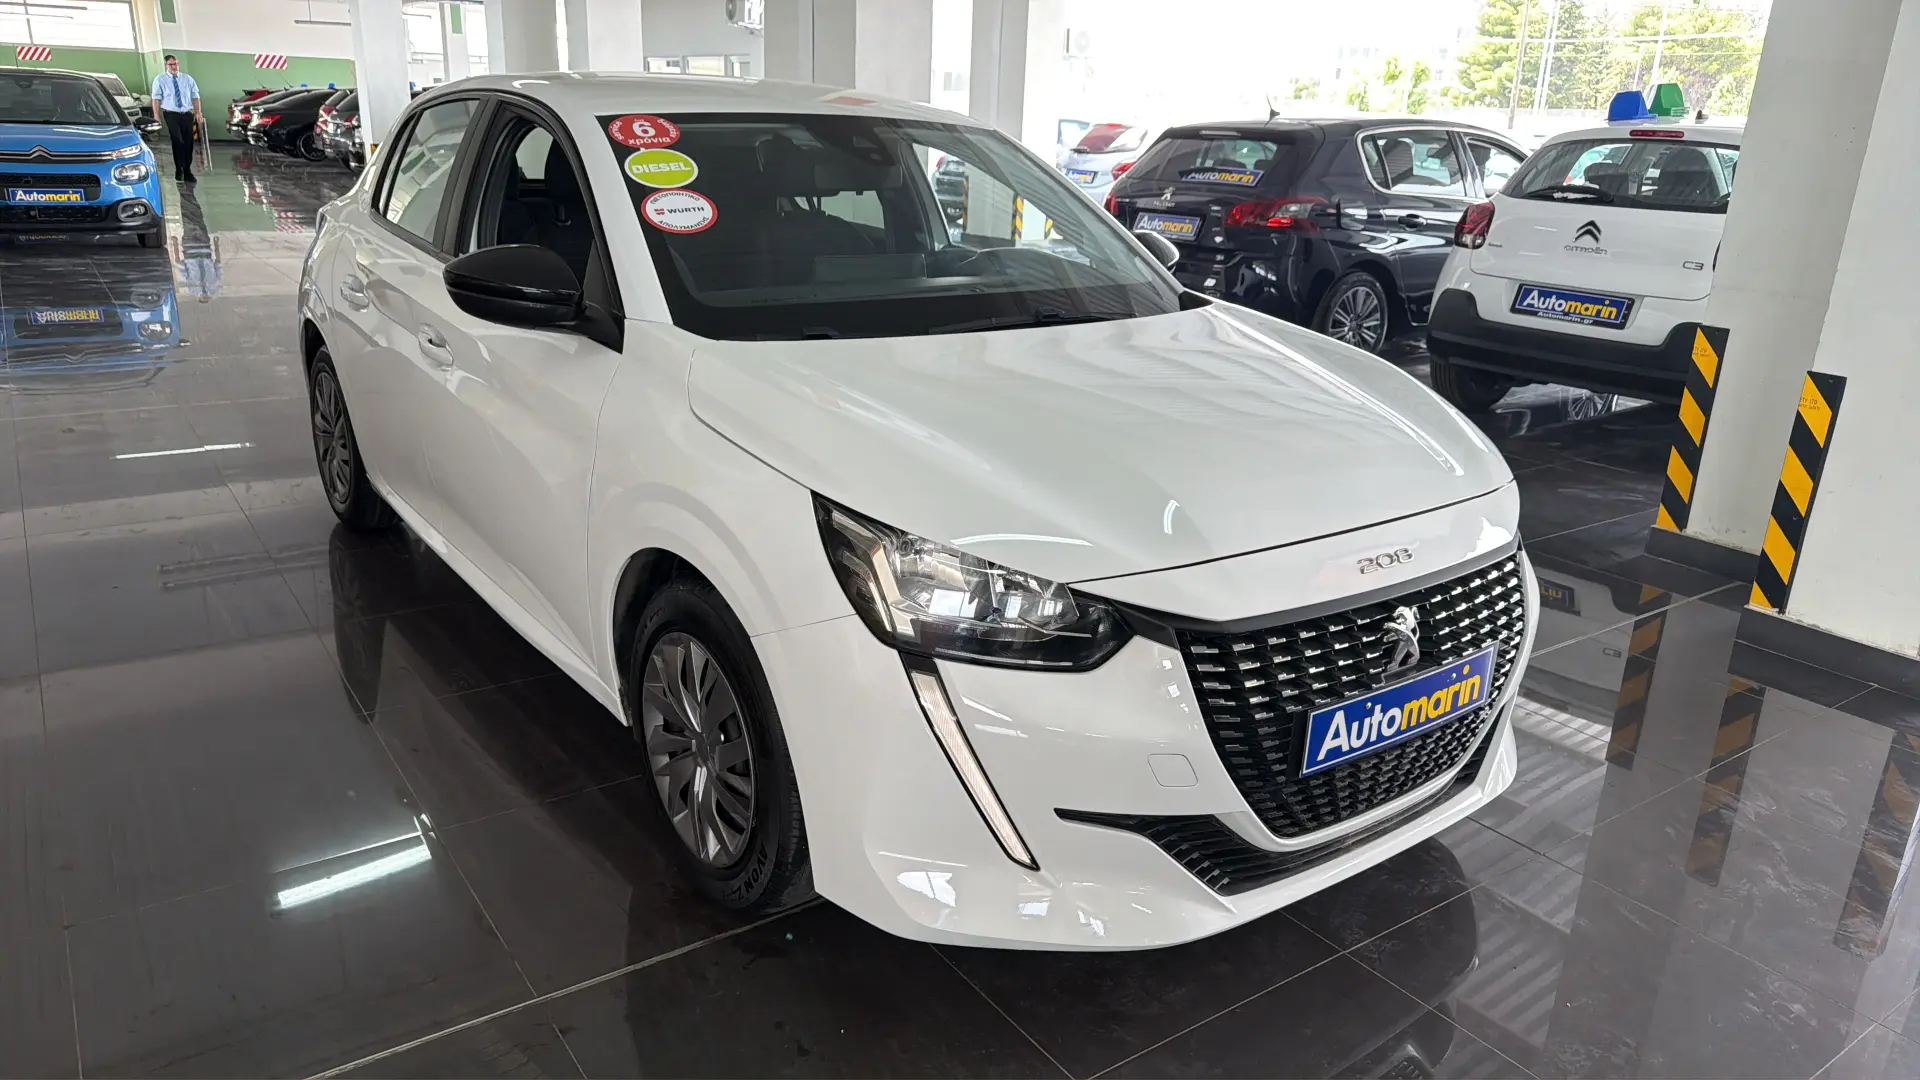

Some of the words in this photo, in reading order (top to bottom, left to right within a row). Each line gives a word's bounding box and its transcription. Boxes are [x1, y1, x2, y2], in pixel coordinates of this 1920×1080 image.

[632, 121, 656, 137] 6
[628, 137, 671, 145] χρόνια
[632, 162, 691, 174] DIESEL
[15, 189, 80, 201] Automarin
[1139, 215, 1193, 233] Automarin
[1682, 261, 1704, 271] C3
[1522, 289, 1617, 320] Automarin
[1537, 311, 1594, 325] Automarin.gr
[1356, 547, 1415, 574] 208
[1316, 664, 1482, 761] Automarin
